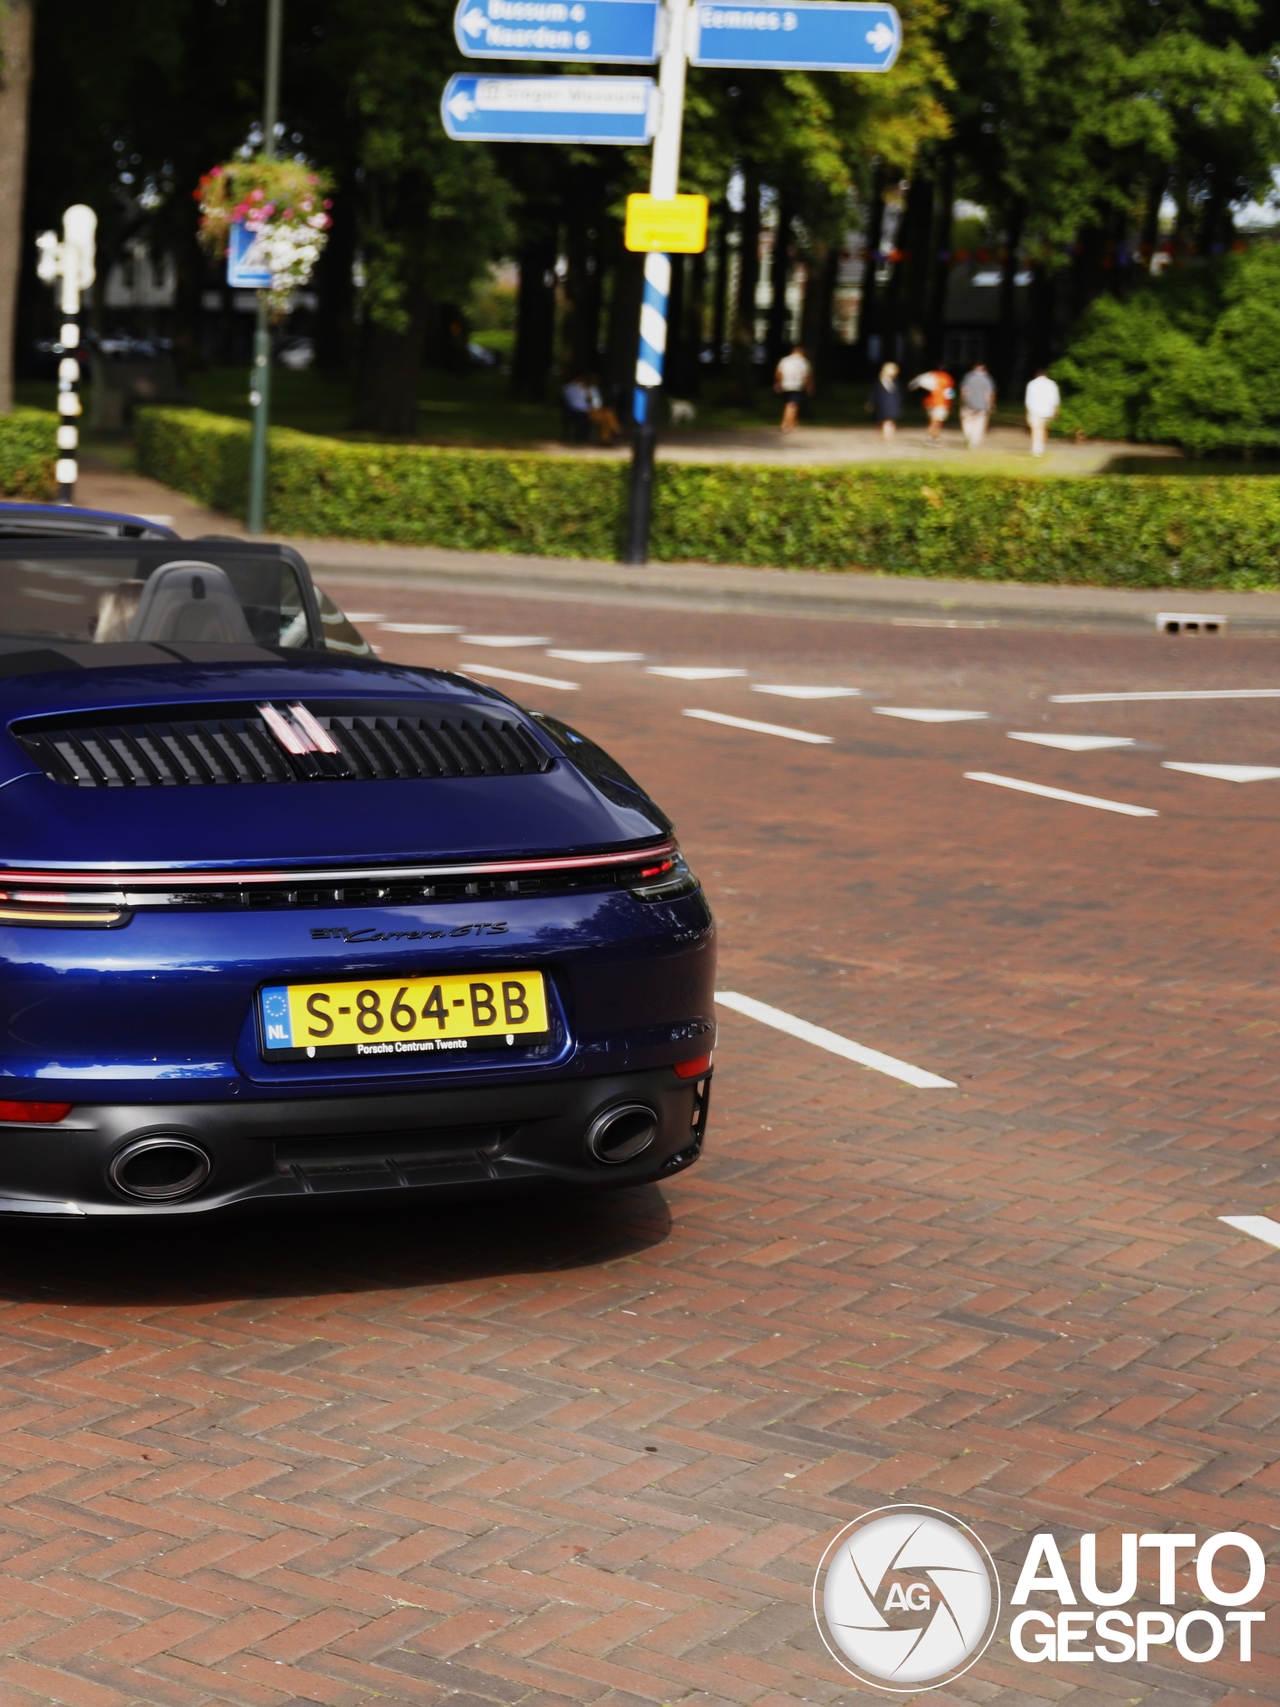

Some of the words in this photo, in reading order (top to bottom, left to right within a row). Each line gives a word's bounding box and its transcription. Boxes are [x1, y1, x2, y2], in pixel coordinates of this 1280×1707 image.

[488, 0, 569, 22] Bussum
[486, 24, 573, 49] Naarden
[575, 30, 591, 50] 6
[310, 927, 348, 939] 911
[343, 928, 446, 943] Carrera
[449, 921, 510, 936] GTS
[306, 980, 530, 1038] S-864-BB
[269, 1024, 289, 1040] NL
[357, 1043, 394, 1055] Porsche
[395, 1041, 434, 1053] Centrum
[435, 1039, 468, 1050] Twente
